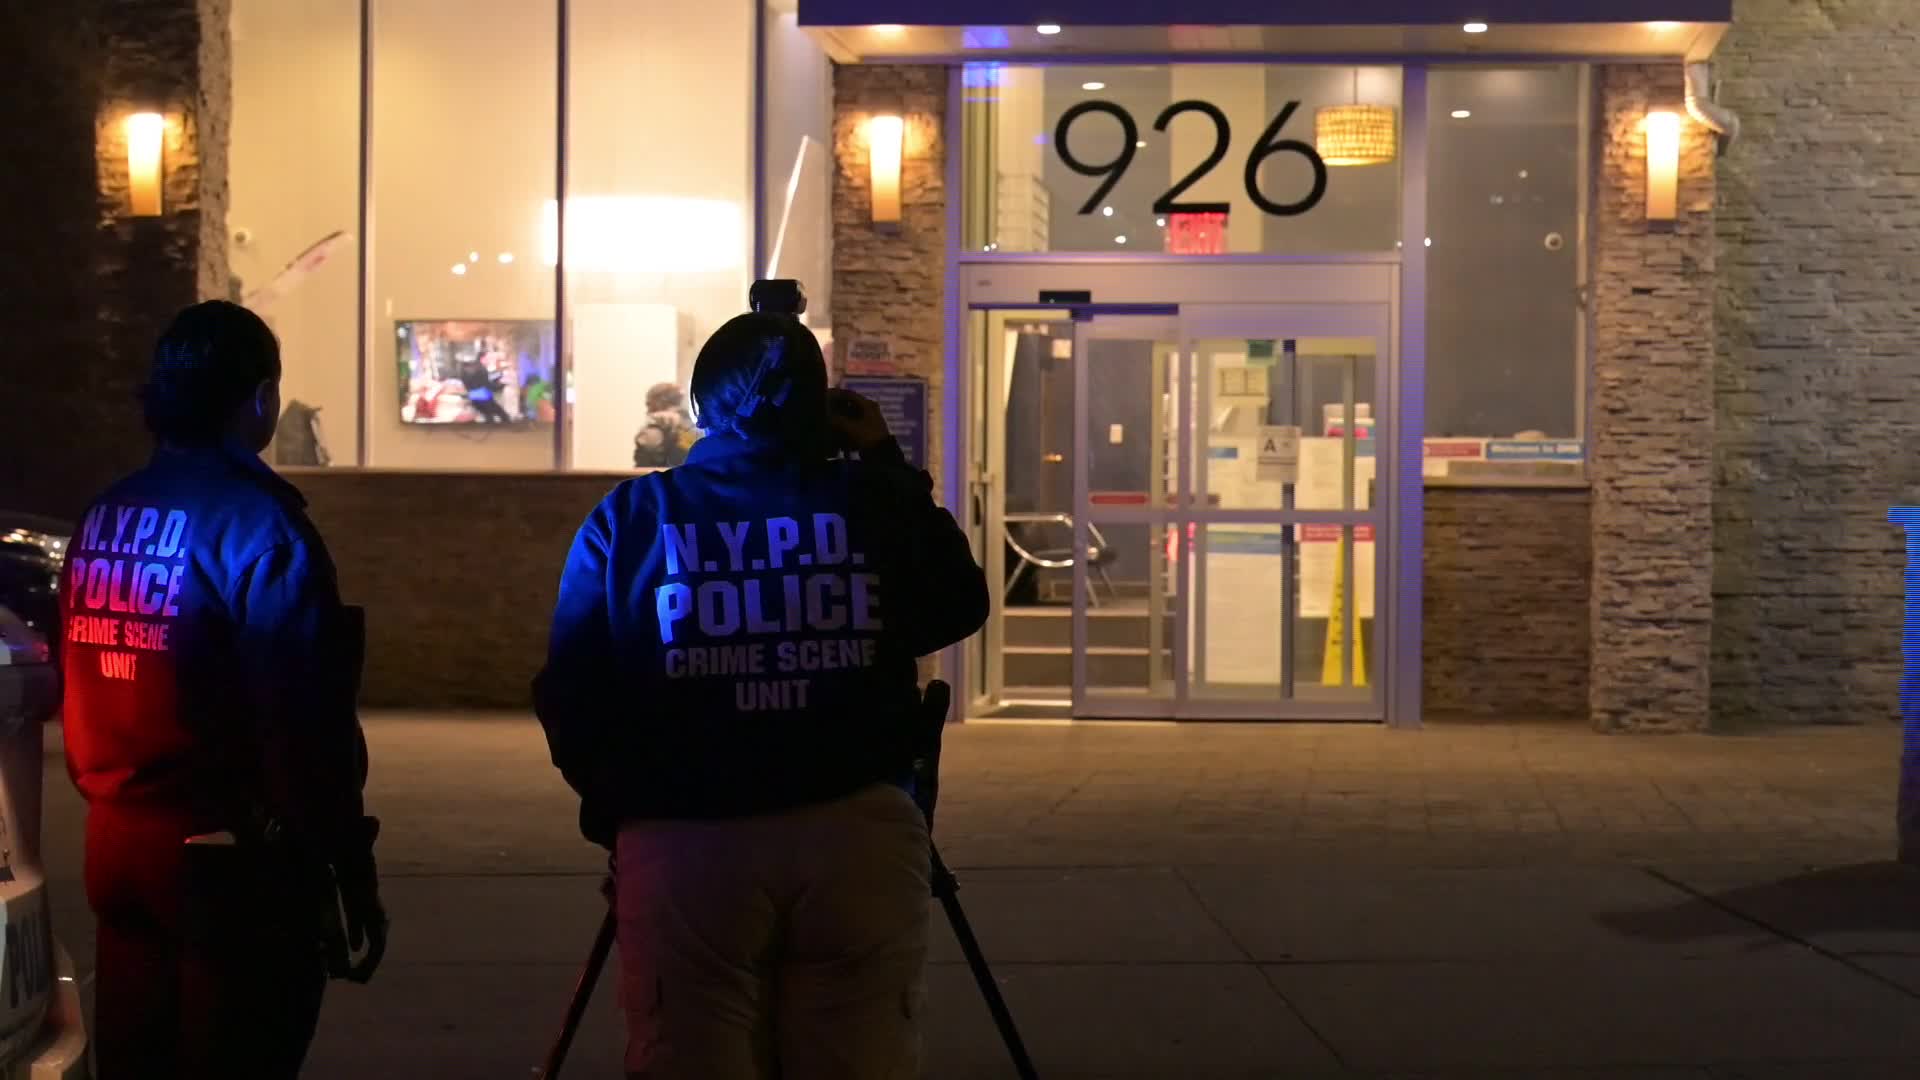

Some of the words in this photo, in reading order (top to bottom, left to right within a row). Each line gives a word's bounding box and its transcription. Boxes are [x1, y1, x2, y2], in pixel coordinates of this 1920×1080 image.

[1054, 99, 1328, 216] 926
[81, 504, 188, 559] N.Y.P.D.
[662, 512, 865, 575] N.Y.P.D.
[69, 557, 185, 617] POLICE
[654, 573, 883, 644] POLICE
[124, 620, 170, 651] SCENE
[665, 643, 765, 679] CRIME
[776, 639, 877, 672] SCENE
[100, 651, 137, 681] UNIT
[735, 679, 811, 712] UNIT
